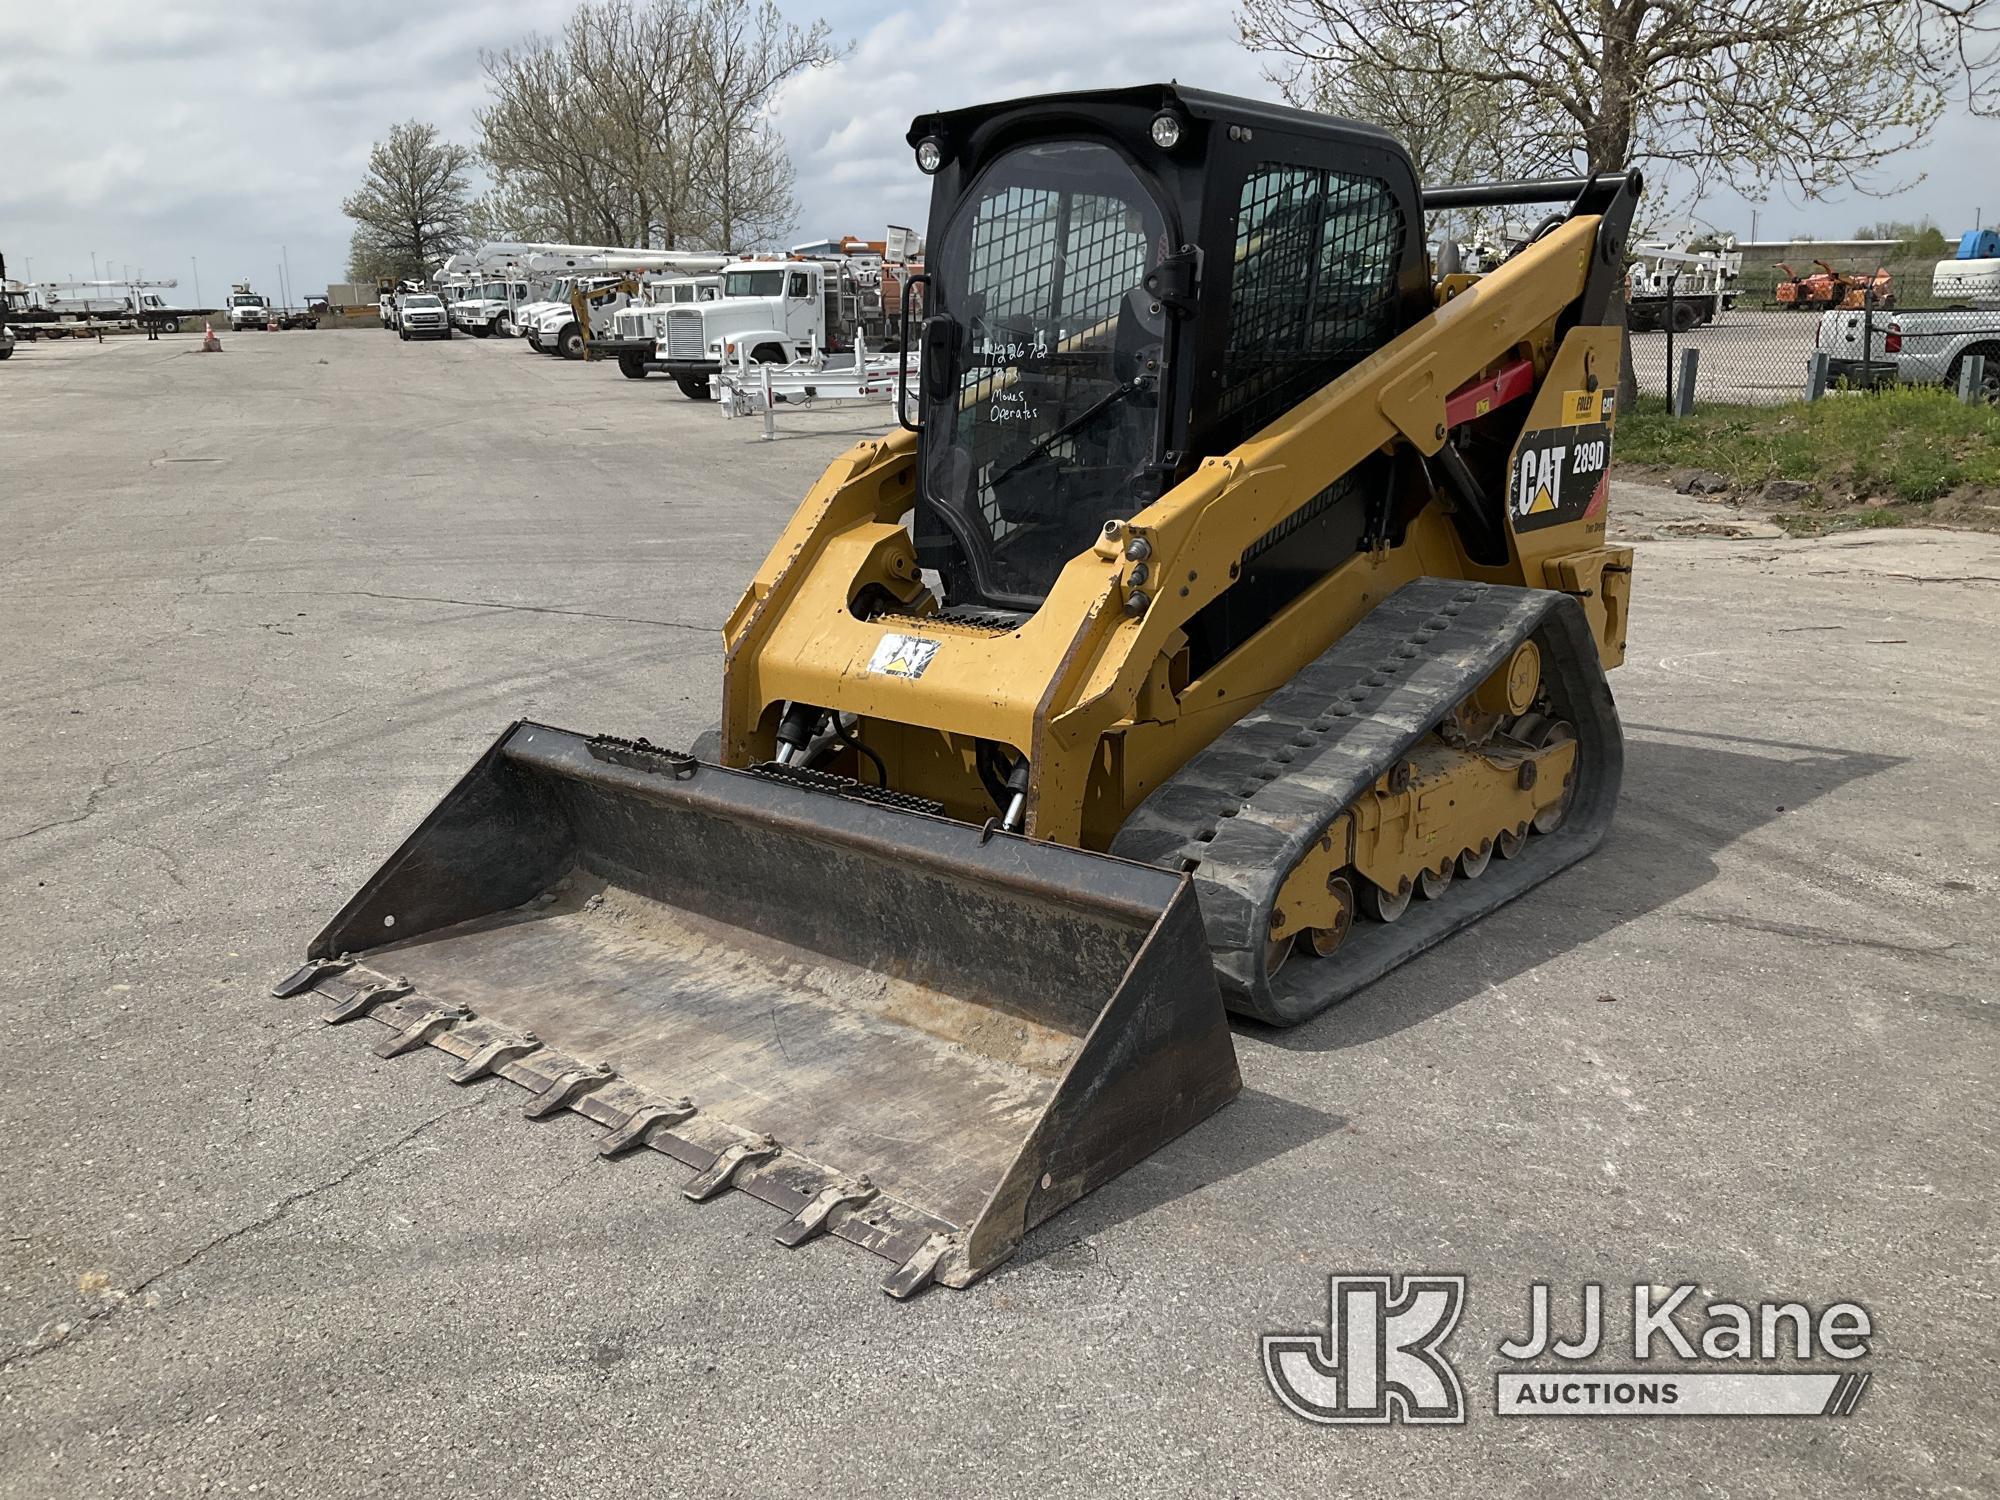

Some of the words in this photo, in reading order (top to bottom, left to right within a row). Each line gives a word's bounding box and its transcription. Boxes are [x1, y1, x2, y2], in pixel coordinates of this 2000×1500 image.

[991, 389, 1024, 402] Moves
[1602, 397, 1614, 413] CAT
[990, 401, 1037, 426] Operates
[1572, 441, 1604, 474] 289D
[1519, 446, 1566, 515] CAT
